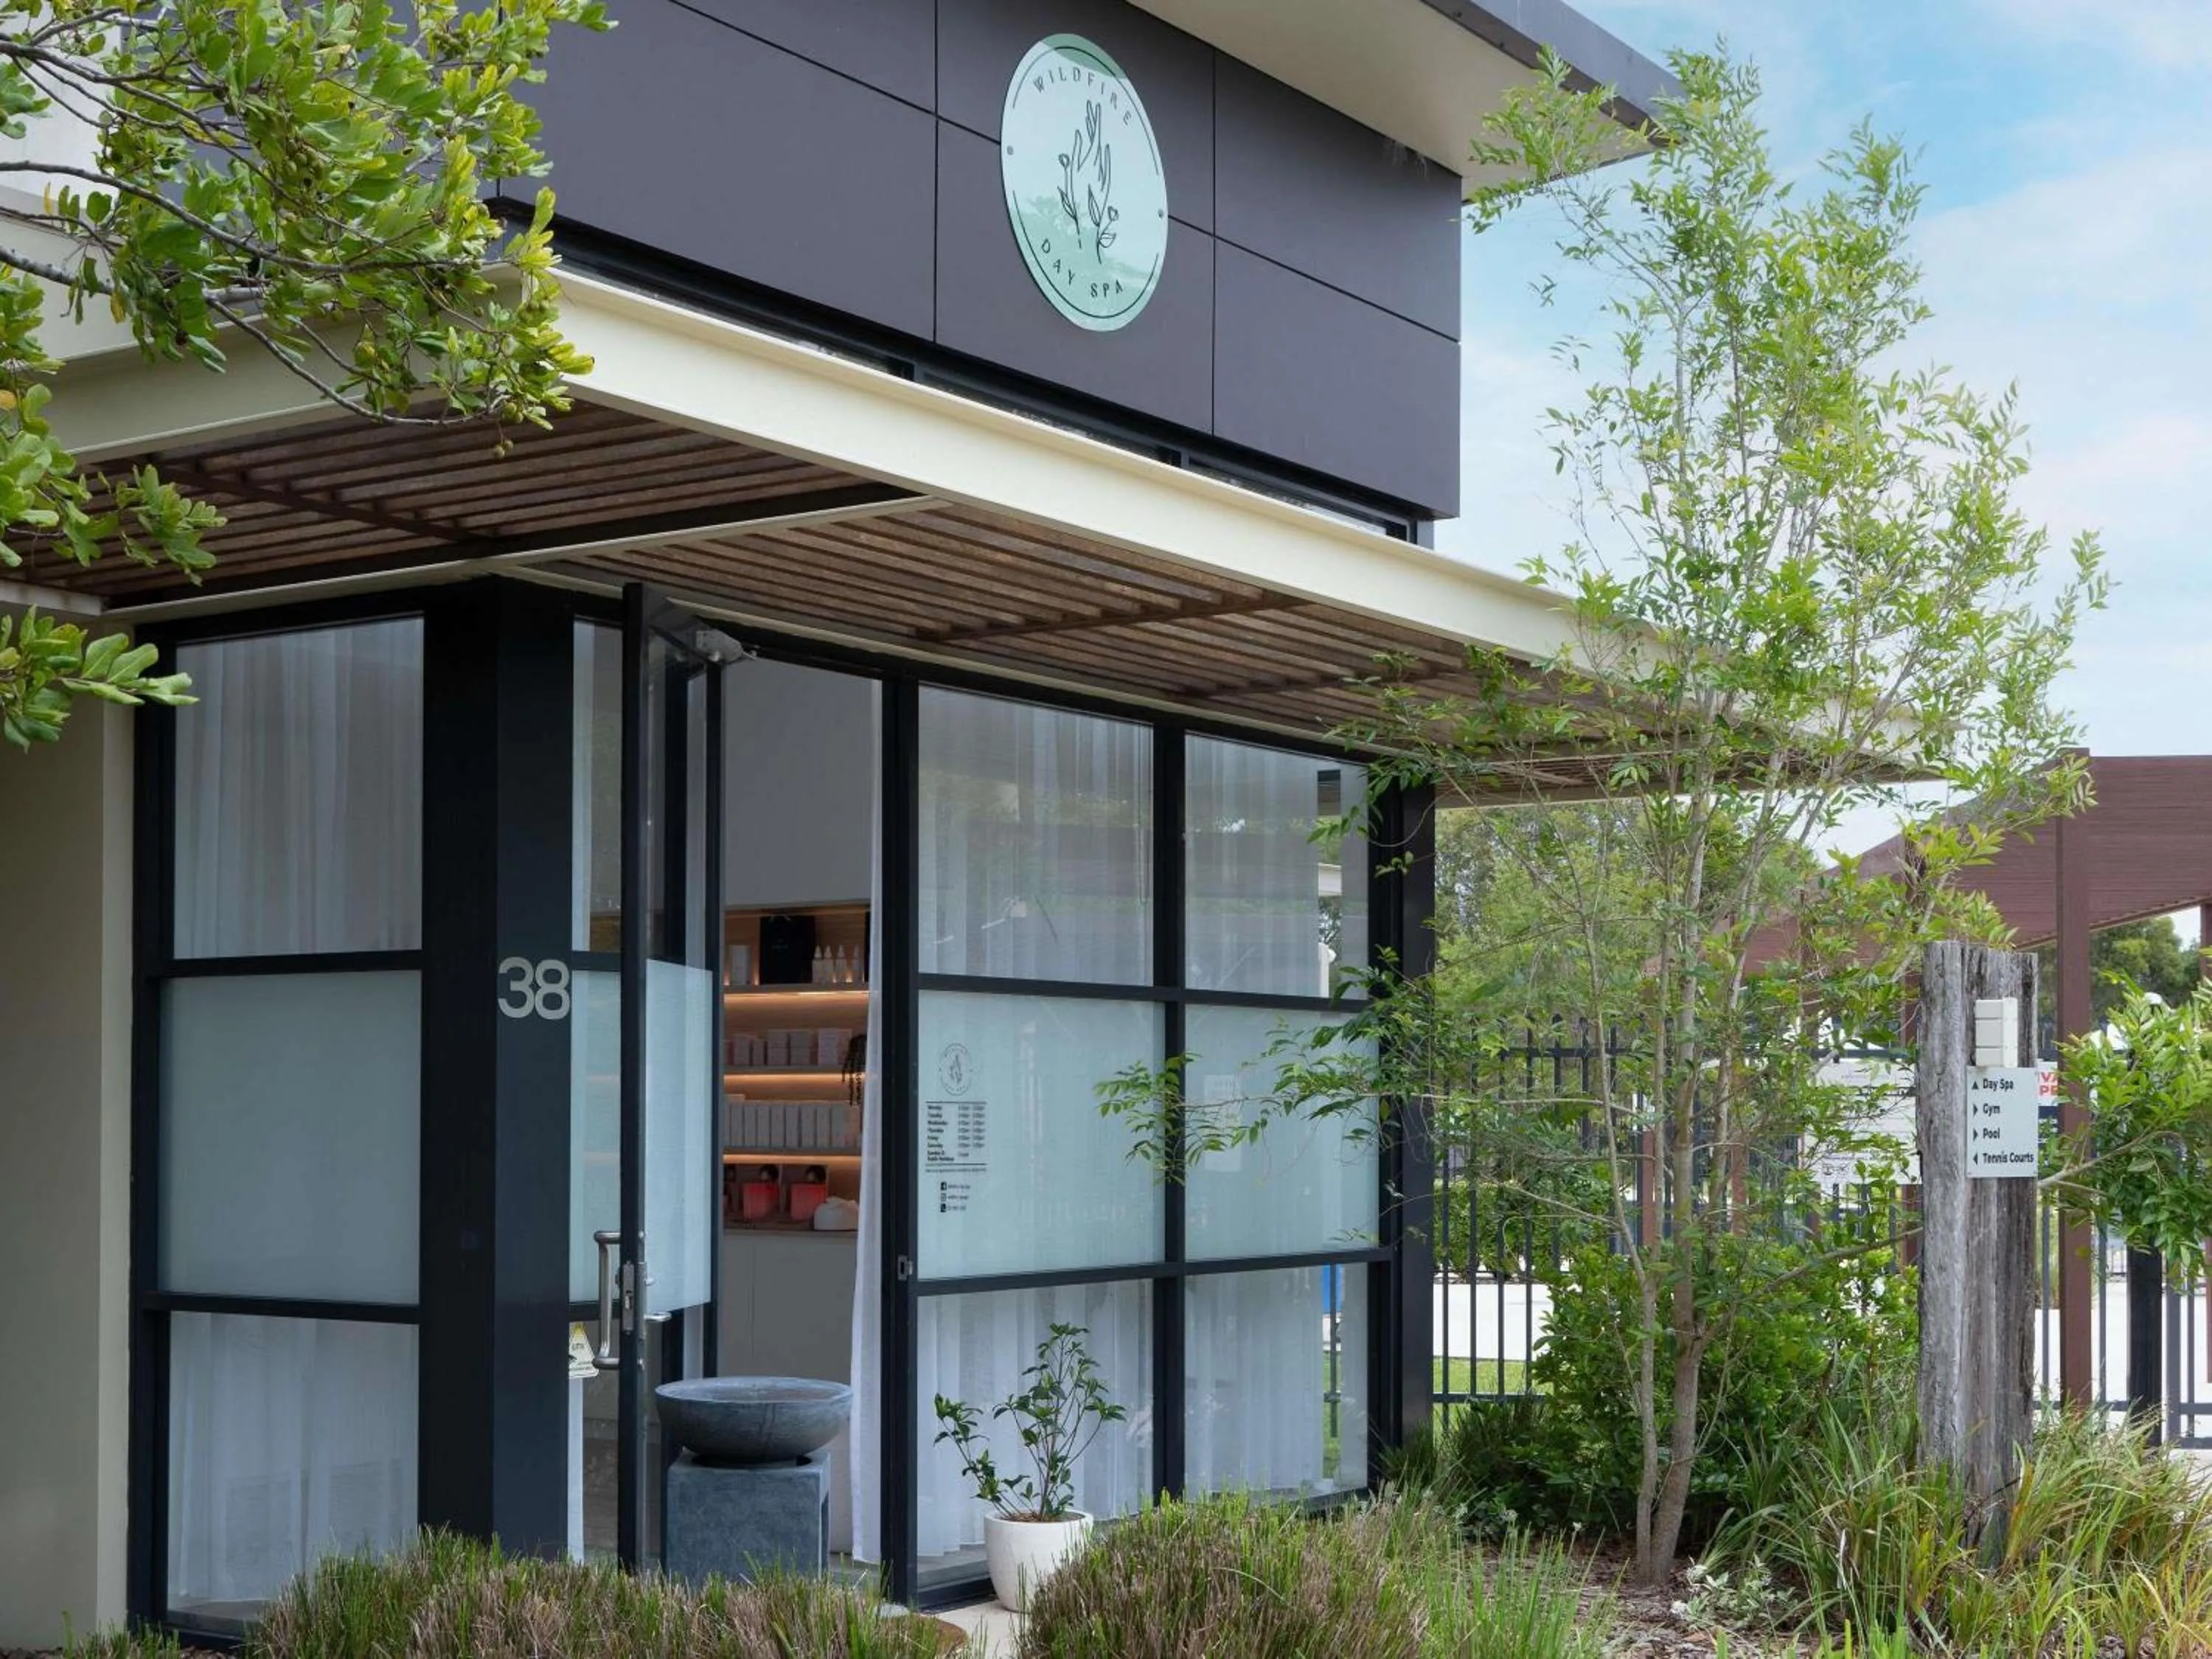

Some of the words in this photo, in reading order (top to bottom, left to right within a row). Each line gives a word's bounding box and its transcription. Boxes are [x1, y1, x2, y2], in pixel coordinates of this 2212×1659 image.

[1033, 66, 1132, 125] WILDFIRE
[1040, 238, 1075, 285] DAY
[1091, 279, 1122, 298] SPA
[498, 957, 570, 1020] 38
[1983, 1078, 1998, 1092] Day
[2000, 1079, 2014, 1092] Spa
[1983, 1102, 2000, 1116] Gym
[1983, 1127, 2000, 1139] Pool
[1983, 1151, 2008, 1164] Tennis
[2009, 1152, 2034, 1163] Courts
